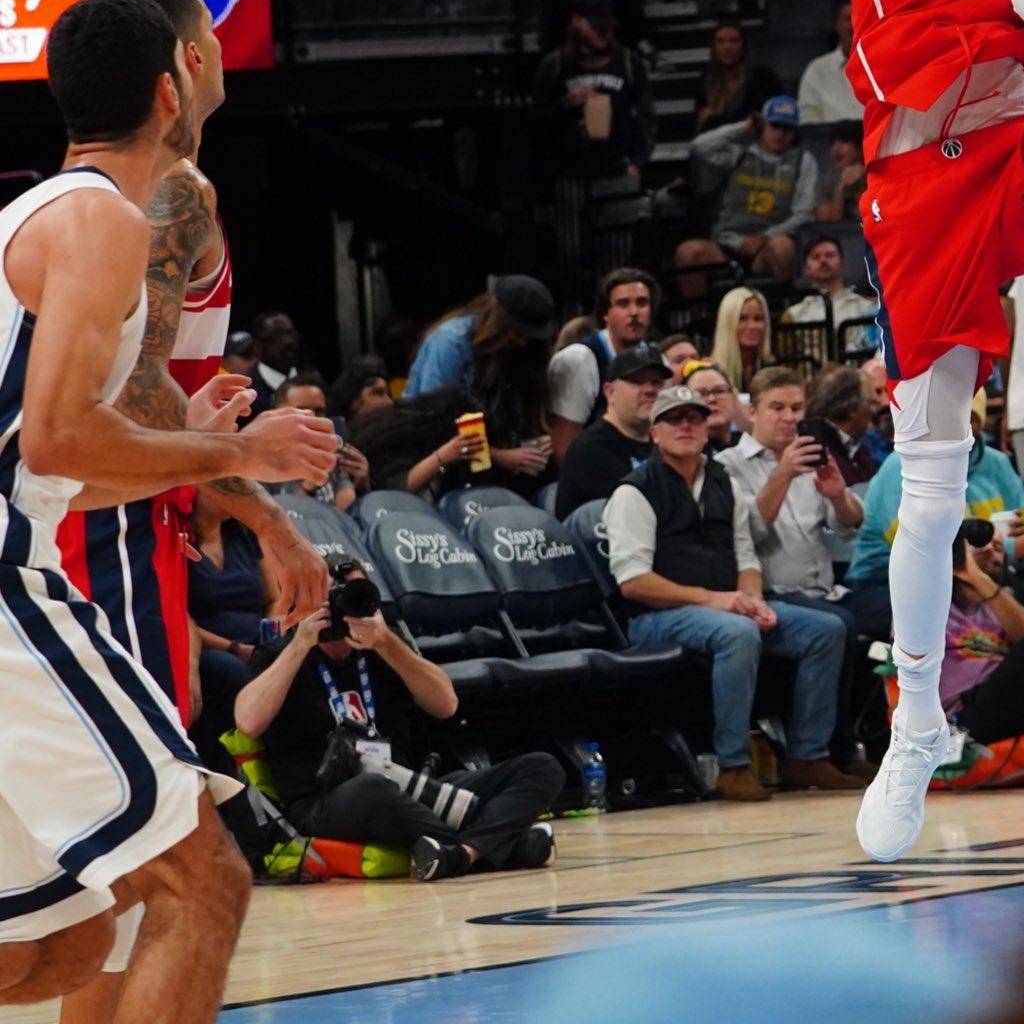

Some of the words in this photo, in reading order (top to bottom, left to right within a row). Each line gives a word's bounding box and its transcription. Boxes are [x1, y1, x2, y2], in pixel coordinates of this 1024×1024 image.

[395, 528, 448, 564] Sissy's
[417, 549, 441, 569] Log
[441, 547, 478, 564] Cabin
[493, 526, 546, 563] Sissy's
[515, 545, 539, 566] Log
[537, 542, 576, 560] Cabin
